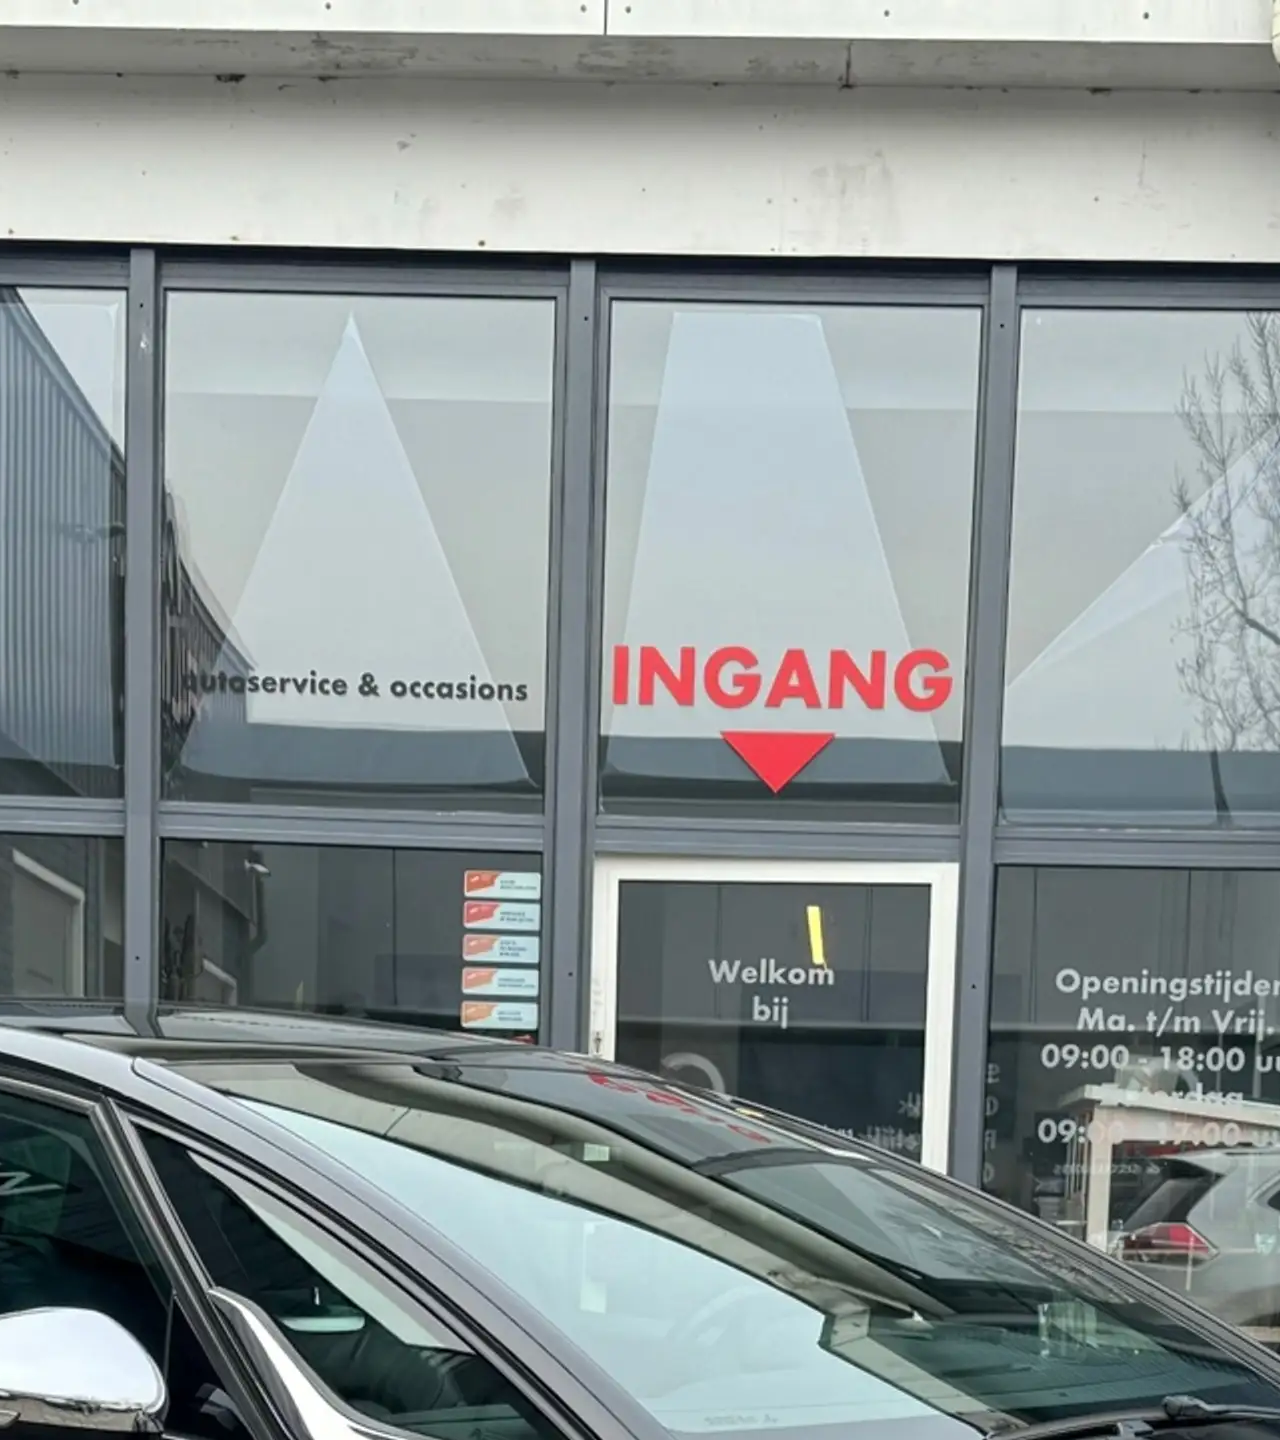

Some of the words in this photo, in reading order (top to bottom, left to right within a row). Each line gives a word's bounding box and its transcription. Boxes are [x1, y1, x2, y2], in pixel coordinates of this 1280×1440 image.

[181, 670, 348, 696] autoservice
[358, 672, 381, 697] &
[390, 674, 528, 702] occasions
[612, 645, 953, 712] INGANG
[708, 958, 835, 985] Welkom
[752, 995, 789, 1029] bij
[1077, 1007, 1136, 1032] Ma.
[1146, 1006, 1201, 1037] t/m
[1211, 1009, 1275, 1042] Vrij.
[1040, 1043, 1130, 1069] 09:00
[1160, 1046, 1245, 1072] 18:00
[1037, 1118, 1125, 1144] 09:00
